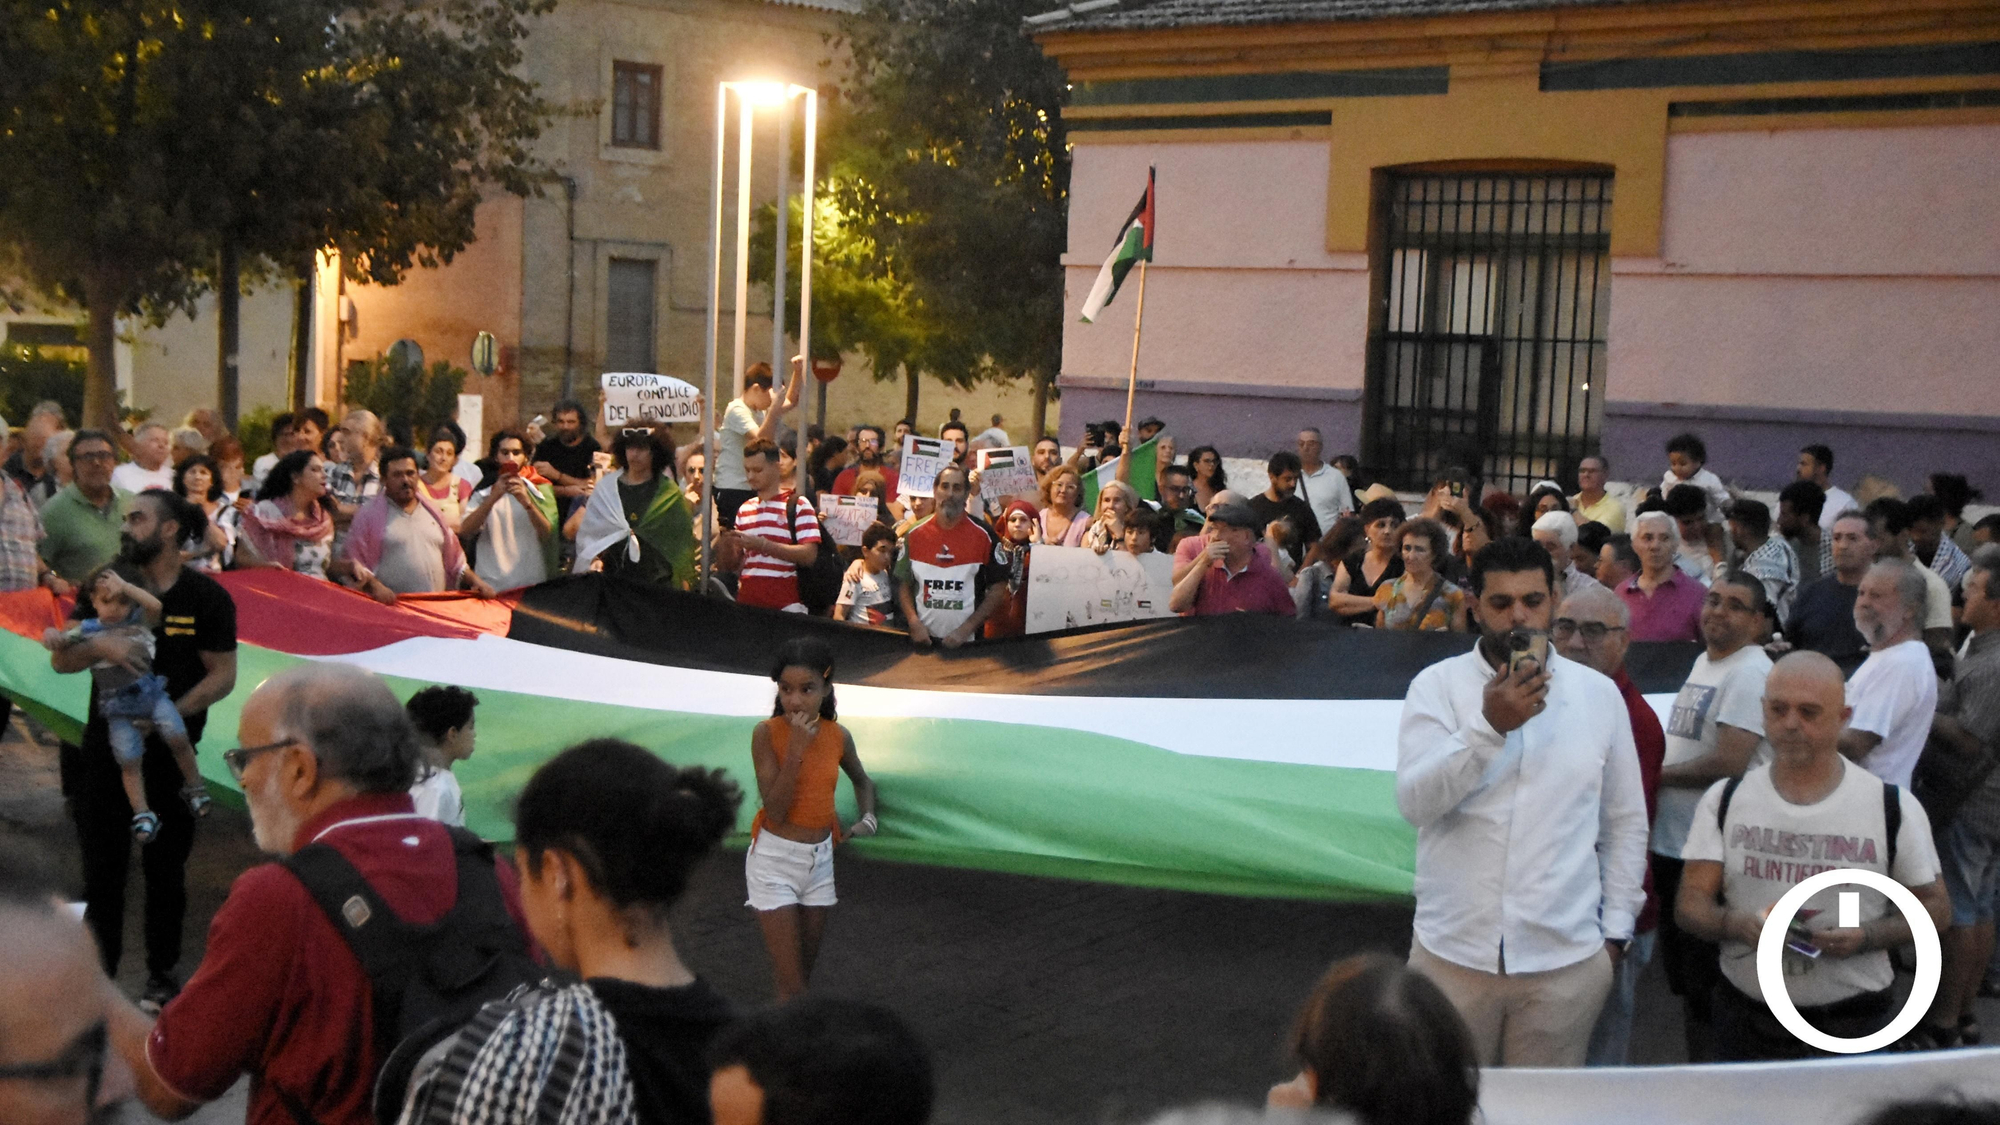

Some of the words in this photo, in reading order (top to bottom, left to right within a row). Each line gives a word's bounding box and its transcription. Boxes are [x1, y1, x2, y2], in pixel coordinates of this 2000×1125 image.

[608, 375, 659, 388] EUROPA
[637, 383, 691, 400] COMPLICE
[609, 404, 629, 421] DEL
[638, 401, 700, 420] GENOCIDIO
[905, 456, 945, 476] FREE
[923, 579, 964, 591] FREE
[1730, 823, 1878, 864] PALESTINA
